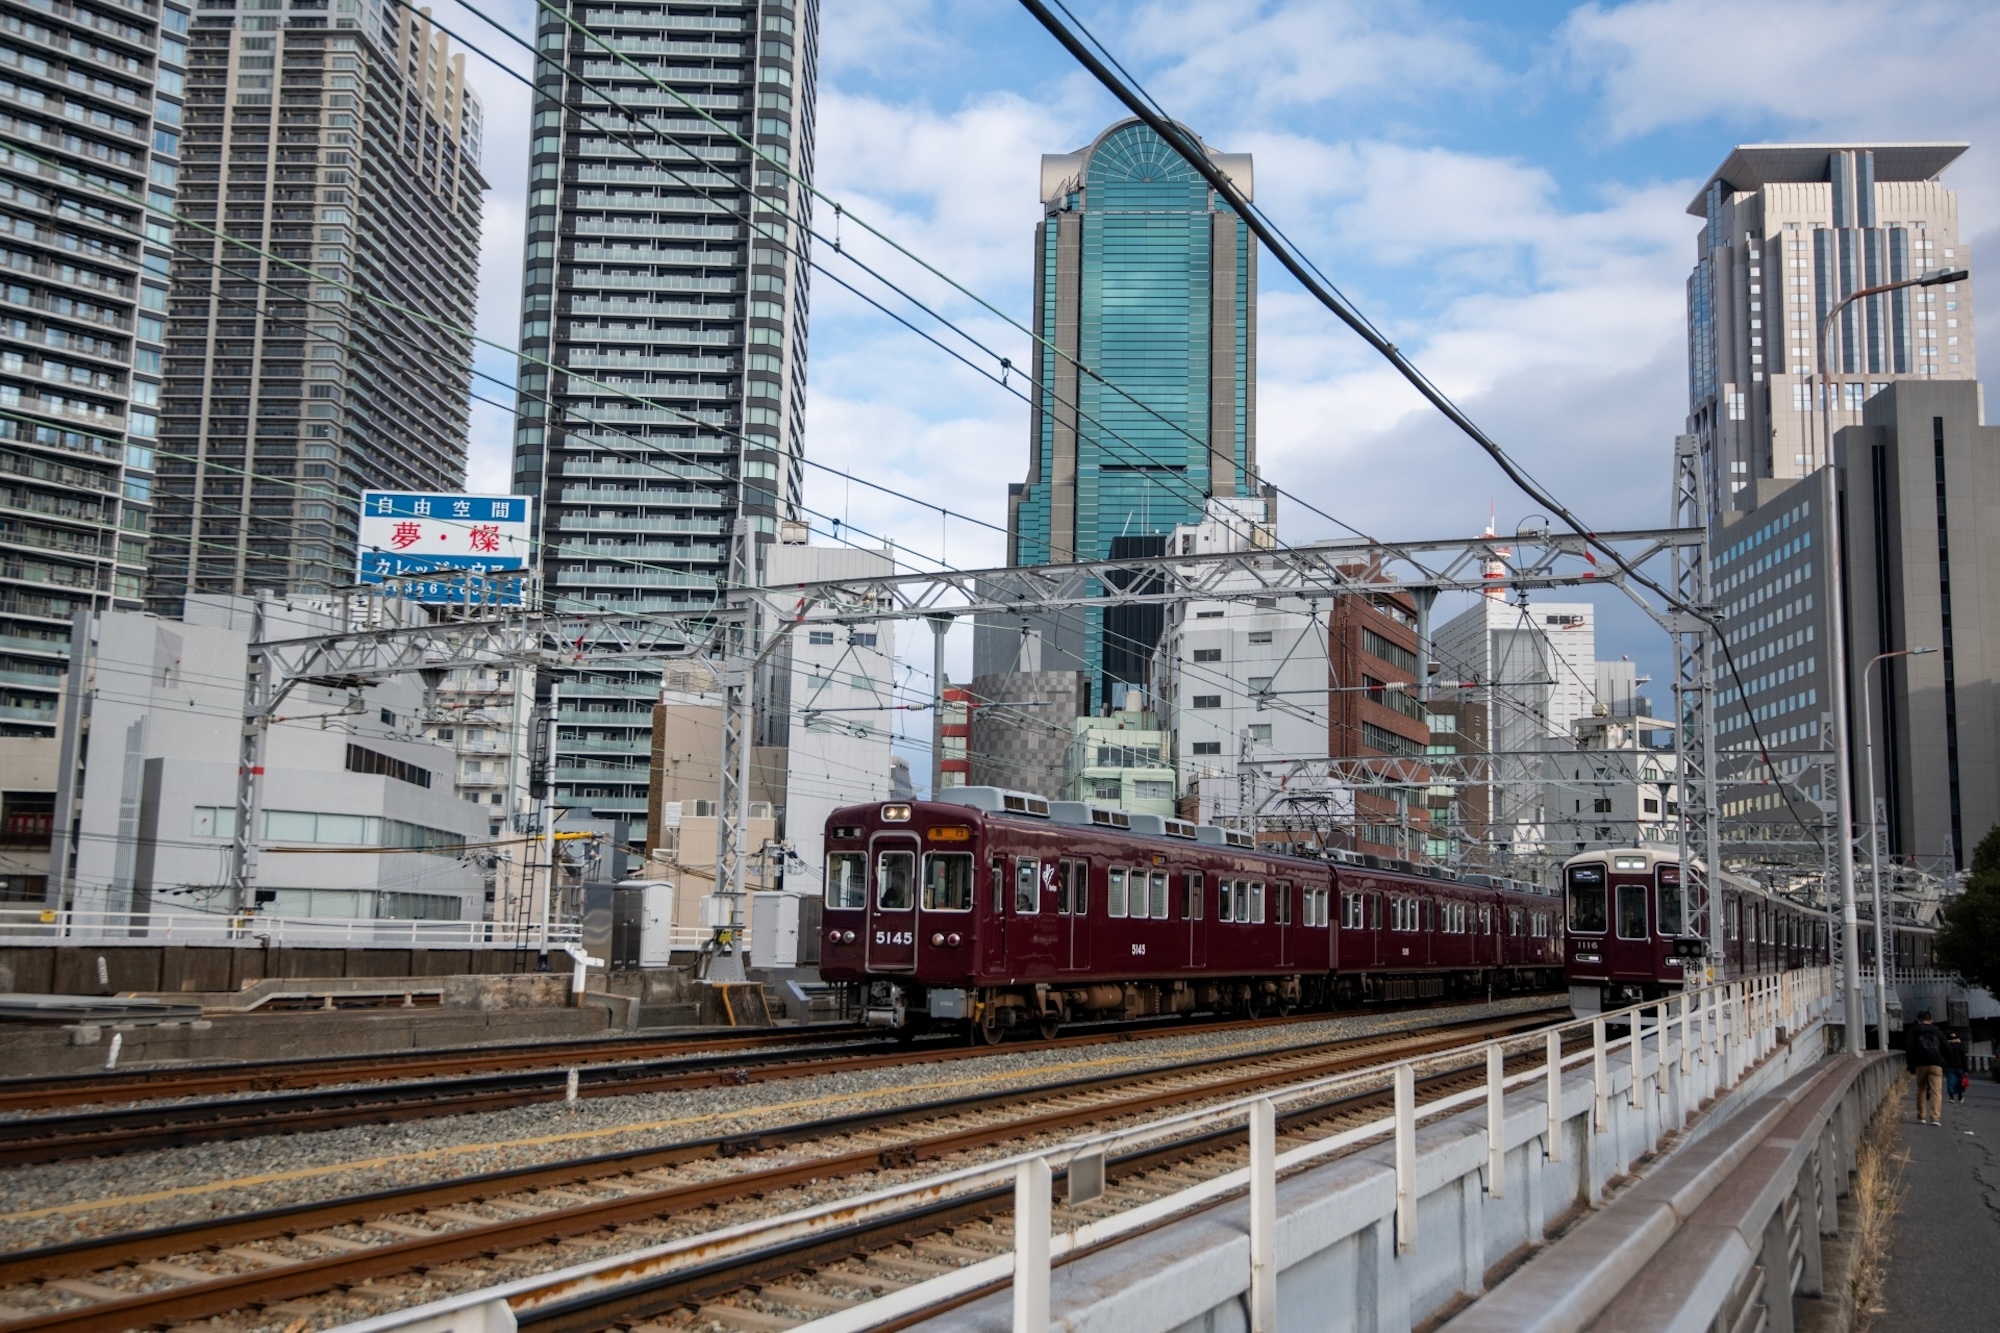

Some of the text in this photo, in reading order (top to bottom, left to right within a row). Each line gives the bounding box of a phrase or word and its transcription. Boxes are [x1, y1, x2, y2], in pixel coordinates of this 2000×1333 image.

[378, 496, 510, 518] 自由空間
[391, 521, 500, 553] 夢・燦
[935, 828, 965, 838] 急行
[876, 931, 913, 945] 5145
[1131, 944, 1146, 955] 5145
[1577, 941, 1598, 950] 1116
[1685, 960, 1702, 975] 神
